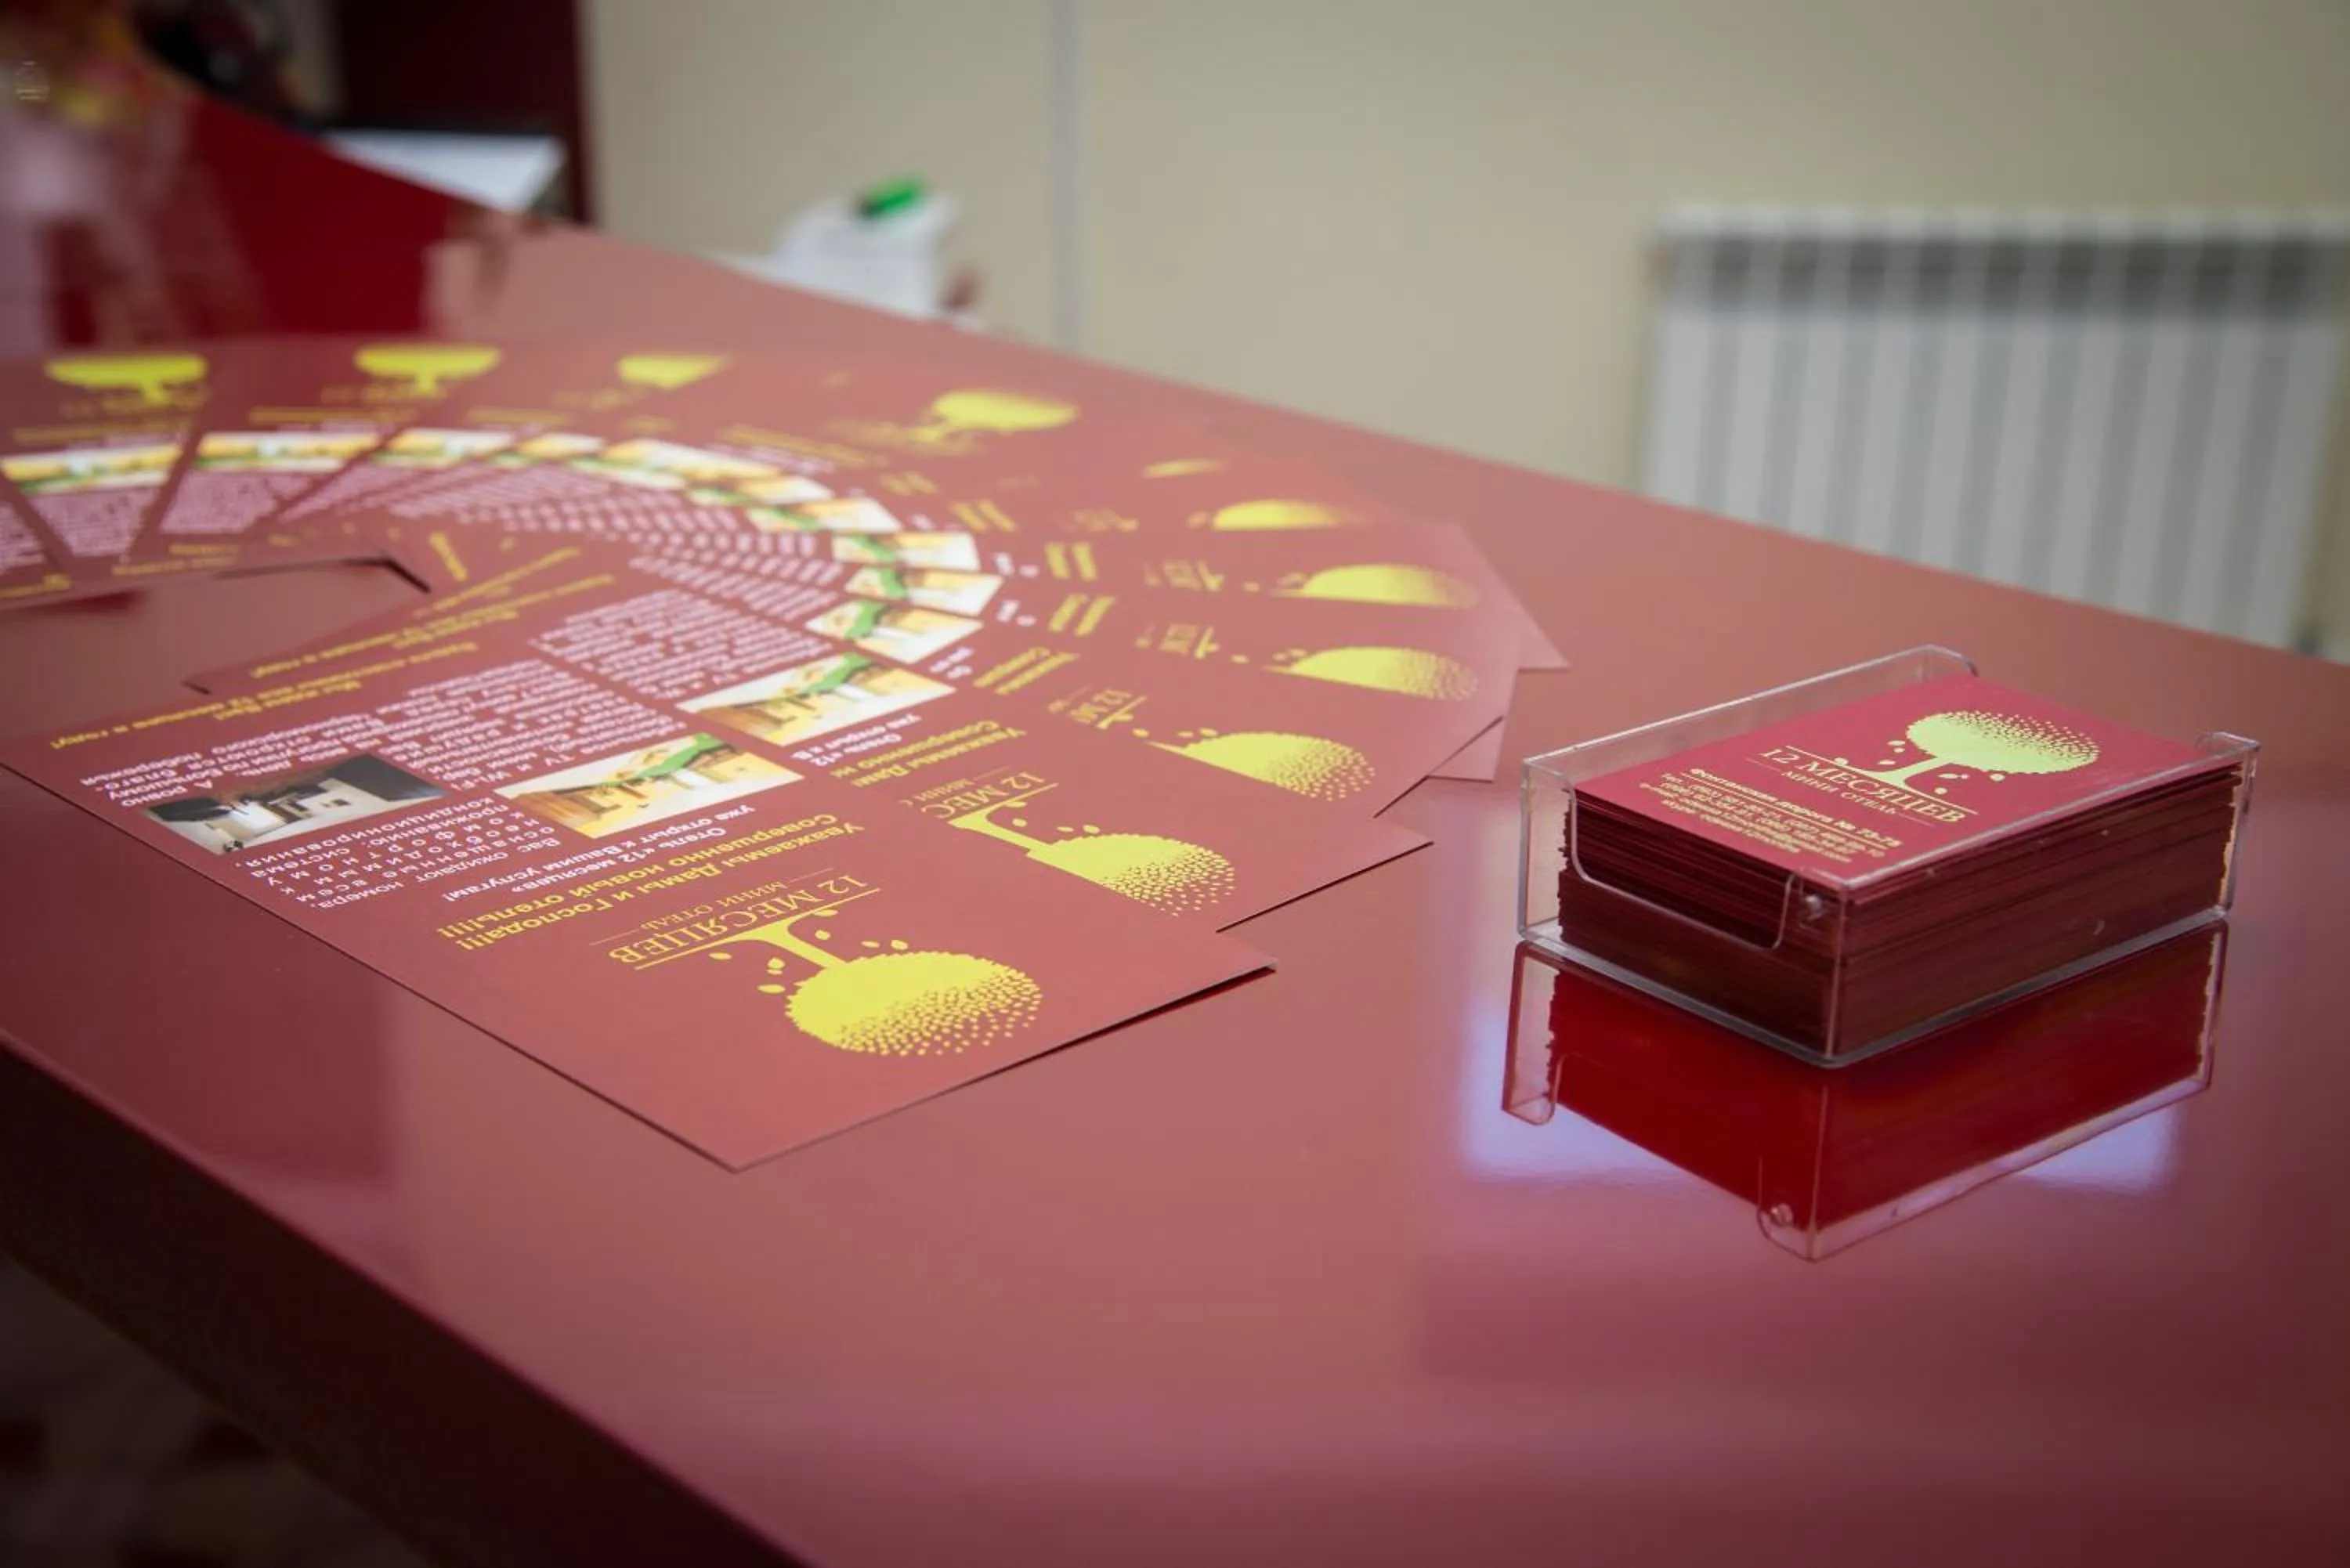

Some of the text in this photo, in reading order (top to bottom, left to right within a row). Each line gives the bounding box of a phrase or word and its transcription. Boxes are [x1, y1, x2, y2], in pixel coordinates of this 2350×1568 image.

[709, 804, 757, 821] уже
[920, 772, 1046, 819] 12 МЕС
[1759, 748, 1800, 765] 12
[1798, 761, 1965, 822] МЕСЯЦЕВ
[540, 844, 624, 873] Вашим
[632, 815, 714, 844] открыт
[247, 847, 353, 878] система
[293, 826, 558, 902] оснащенные всем
[308, 836, 563, 910] Вас ожидают номера,
[434, 811, 841, 936] Совершенно новый отель!!!!
[439, 867, 542, 901] услугам!
[453, 821, 866, 950] Уважаемы Дамы и Господа!!!
[508, 826, 729, 894] Отель «12 месяцев»
[601, 873, 870, 963] 12 МЕСЯЦЕВ
[637, 880, 789, 931] МИНИ ОТЕЛЬ
